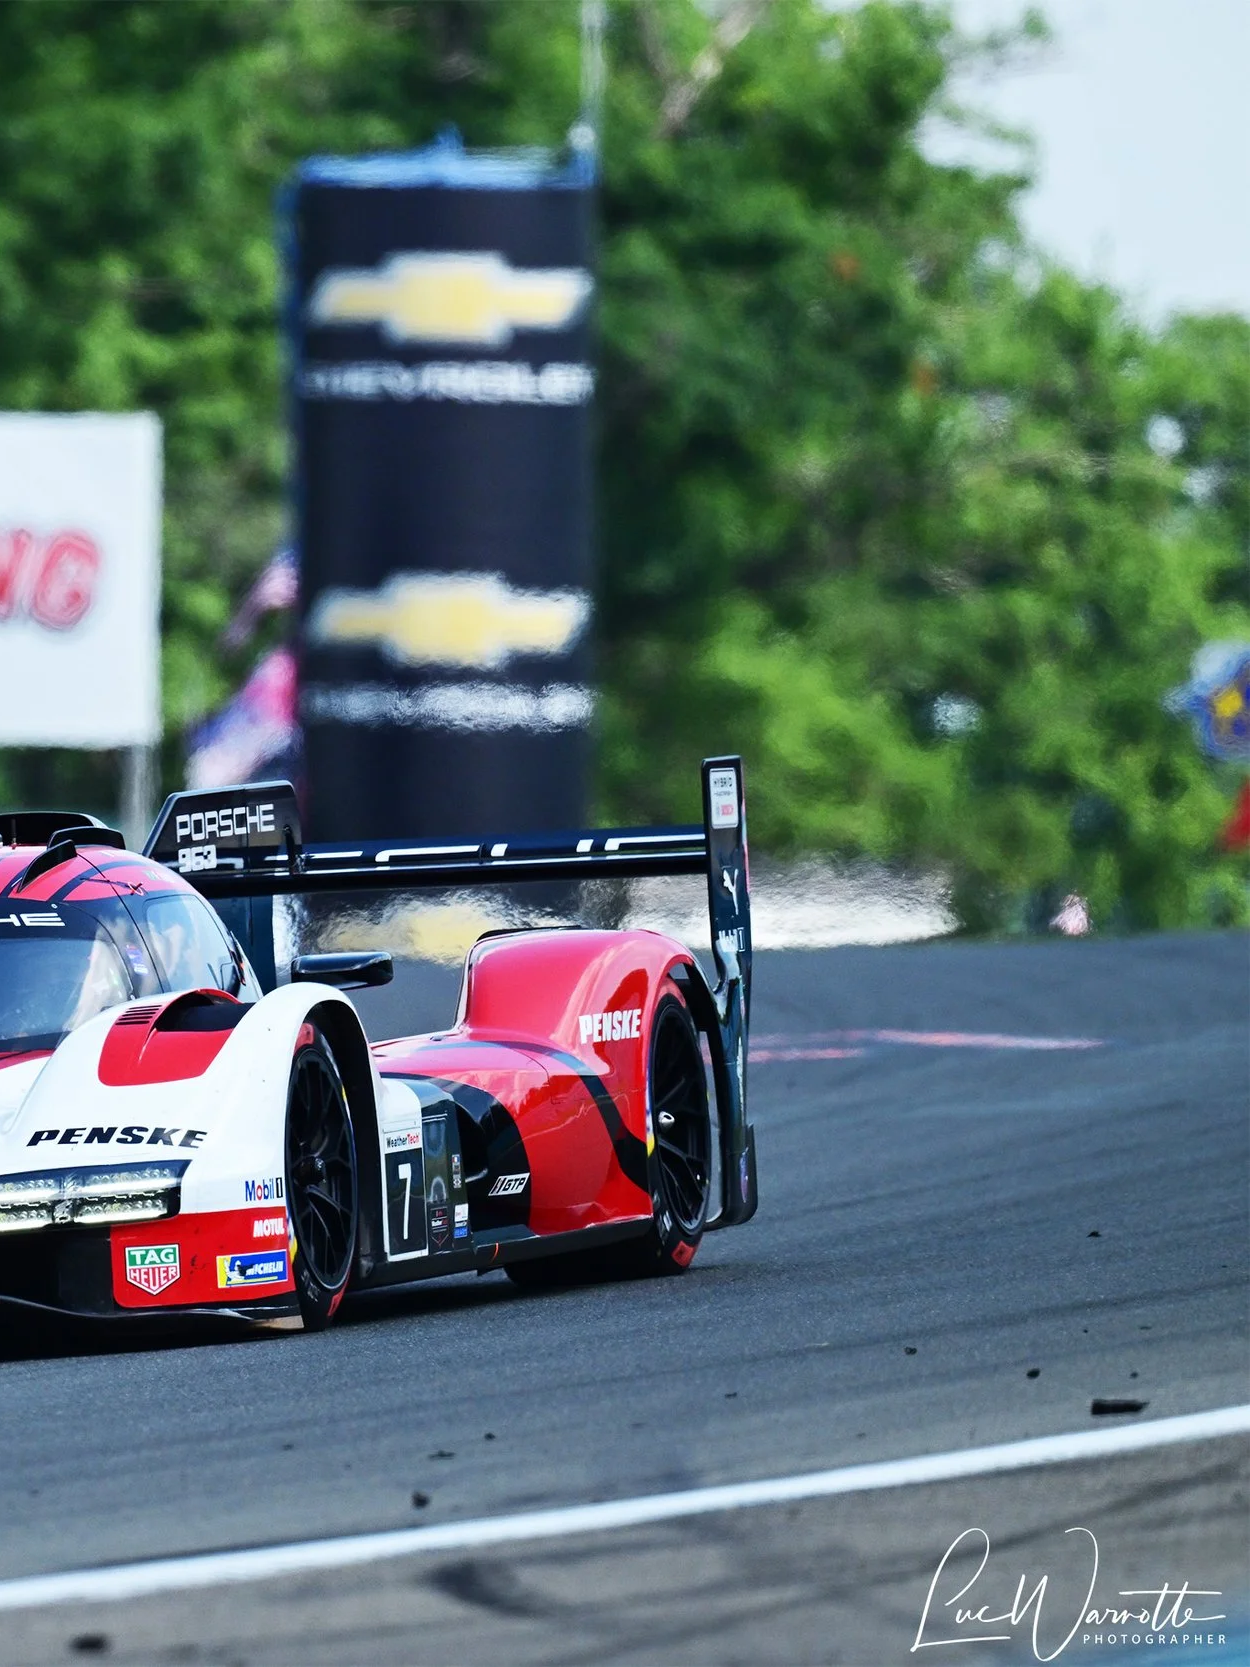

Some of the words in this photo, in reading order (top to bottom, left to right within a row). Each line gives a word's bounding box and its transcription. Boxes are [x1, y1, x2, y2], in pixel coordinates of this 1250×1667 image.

[175, 803, 276, 843] PORSCHE
[177, 844, 217, 873] 963
[578, 1008, 642, 1045] PENSKE
[25, 1126, 208, 1149] PENSKE
[386, 1132, 420, 1149] WeatherTech
[245, 1179, 275, 1202] Mobil
[275, 1177, 283, 1199] 1
[502, 1176, 527, 1192] GTP
[398, 1163, 412, 1240] 7
[253, 1217, 285, 1238] MOTUL
[130, 1248, 175, 1265] TAG
[130, 1266, 178, 1291] HEUER
